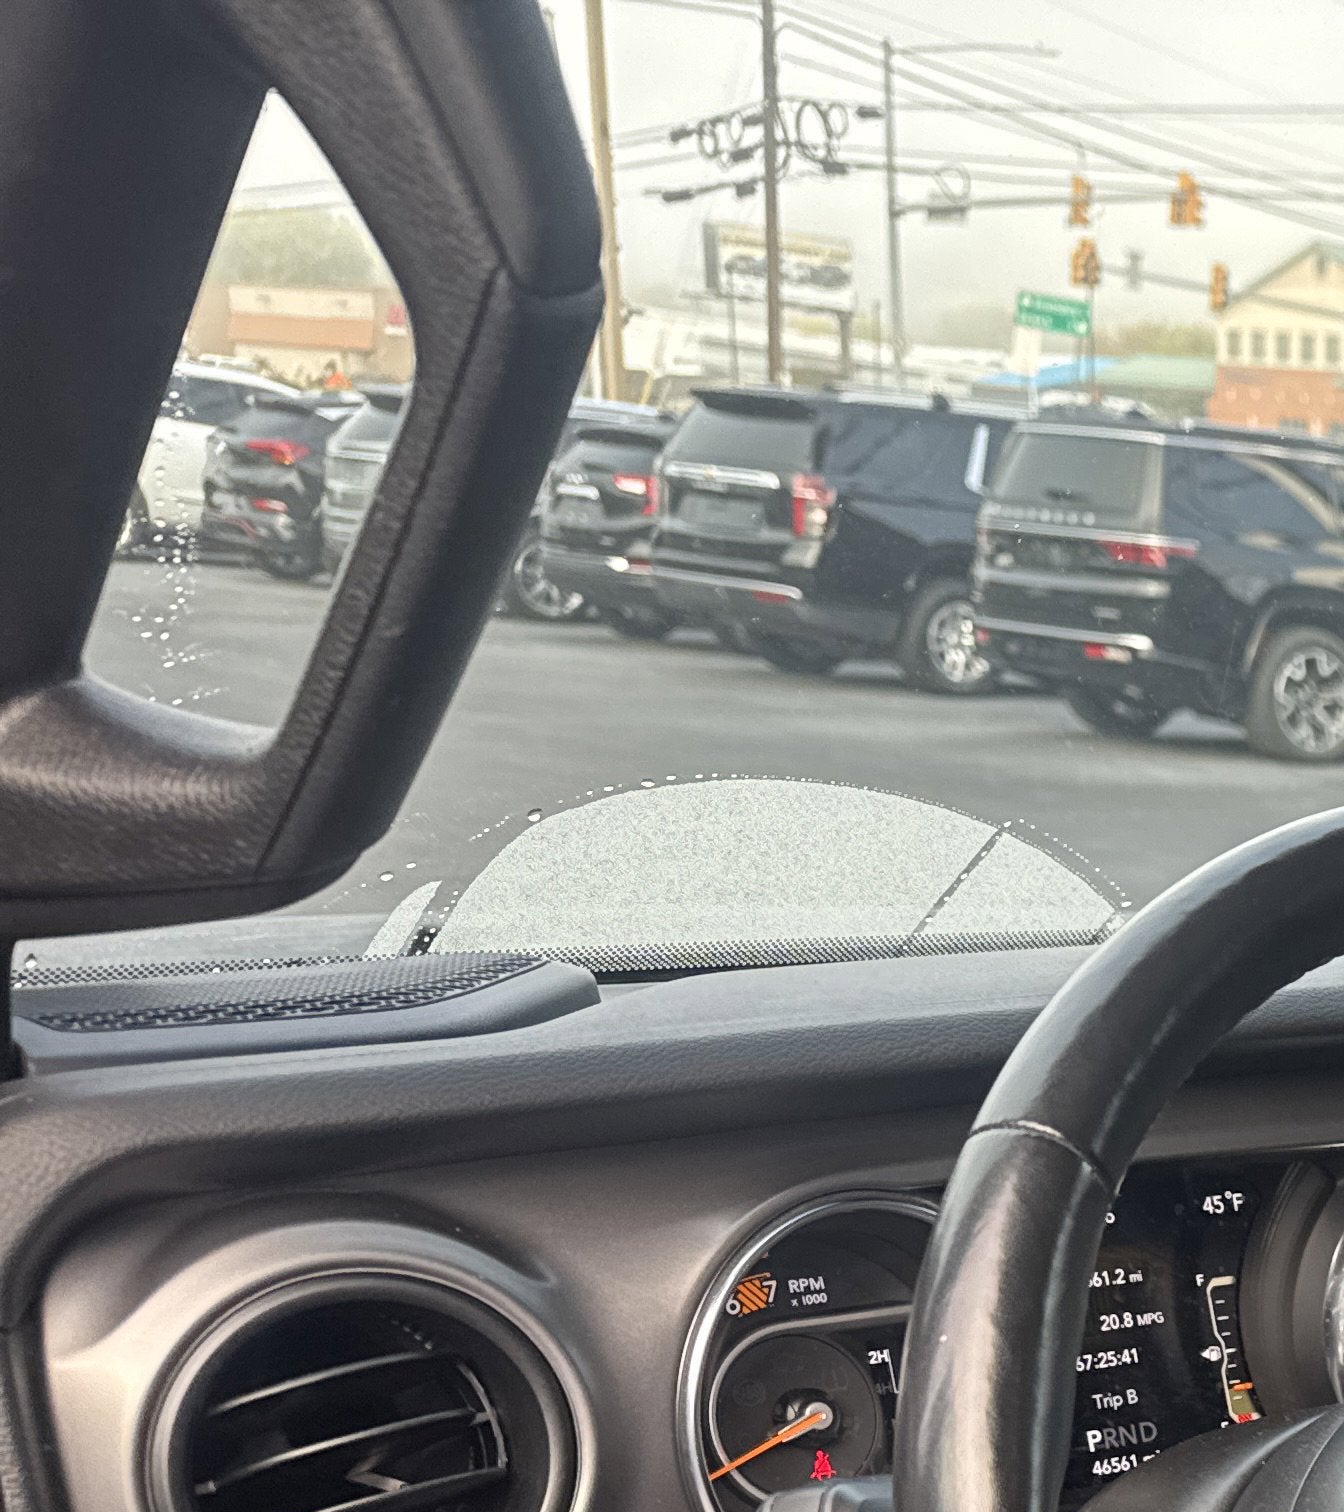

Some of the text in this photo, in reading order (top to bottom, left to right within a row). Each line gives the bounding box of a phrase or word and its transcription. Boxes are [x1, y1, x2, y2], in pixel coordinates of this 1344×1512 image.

[1202, 1190, 1244, 1215] 45°F
[788, 1276, 826, 1294] RPM
[1128, 1270, 1144, 1283] mi
[1195, 1273, 1205, 1287] F
[762, 1280, 778, 1303] 7
[802, 1292, 828, 1306] 1000
[725, 1292, 741, 1316] 6
[1099, 1311, 1165, 1332] 20.8 MPG
[867, 1349, 890, 1365] 2H
[1091, 1388, 1139, 1411] Trip B
[1092, 1453, 1138, 1476] 46561
